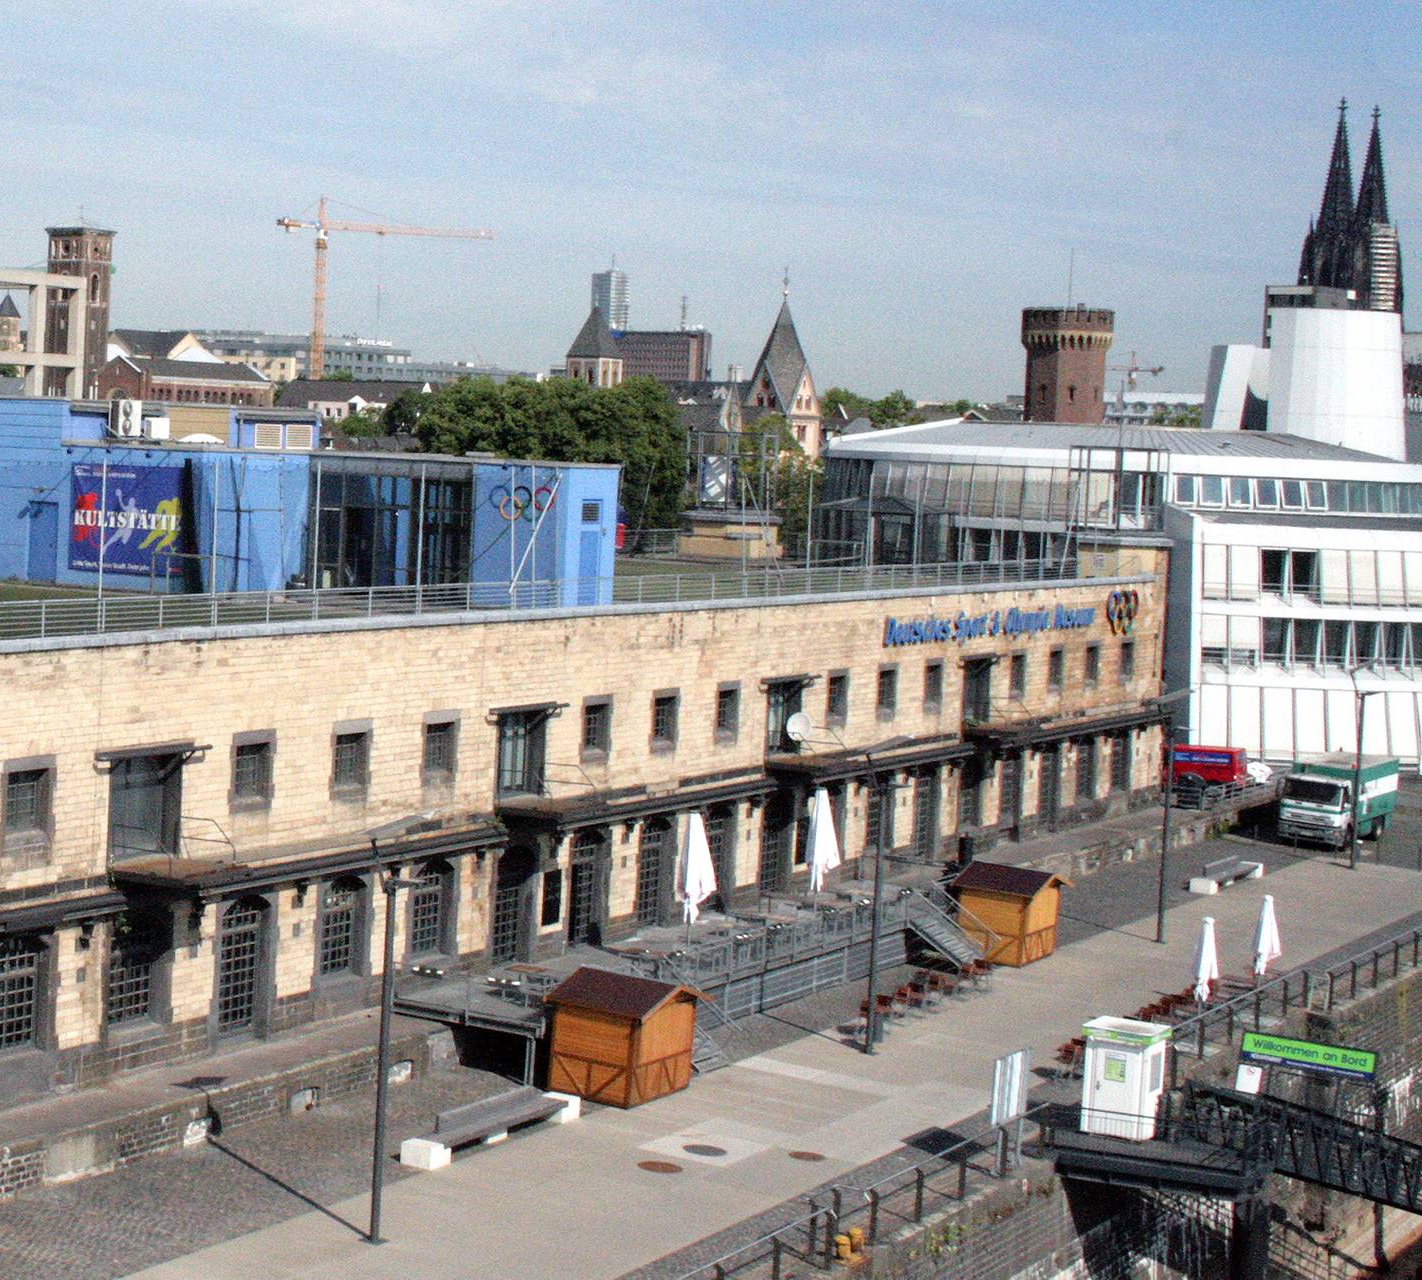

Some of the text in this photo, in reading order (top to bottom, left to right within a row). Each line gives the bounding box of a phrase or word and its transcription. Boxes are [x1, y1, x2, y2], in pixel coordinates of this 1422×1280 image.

[955, 611, 988, 644] Sport
[1252, 1038, 1319, 1059] Willkommen
[1323, 1052, 1338, 1062] an
[1341, 1055, 1368, 1067] Bord
